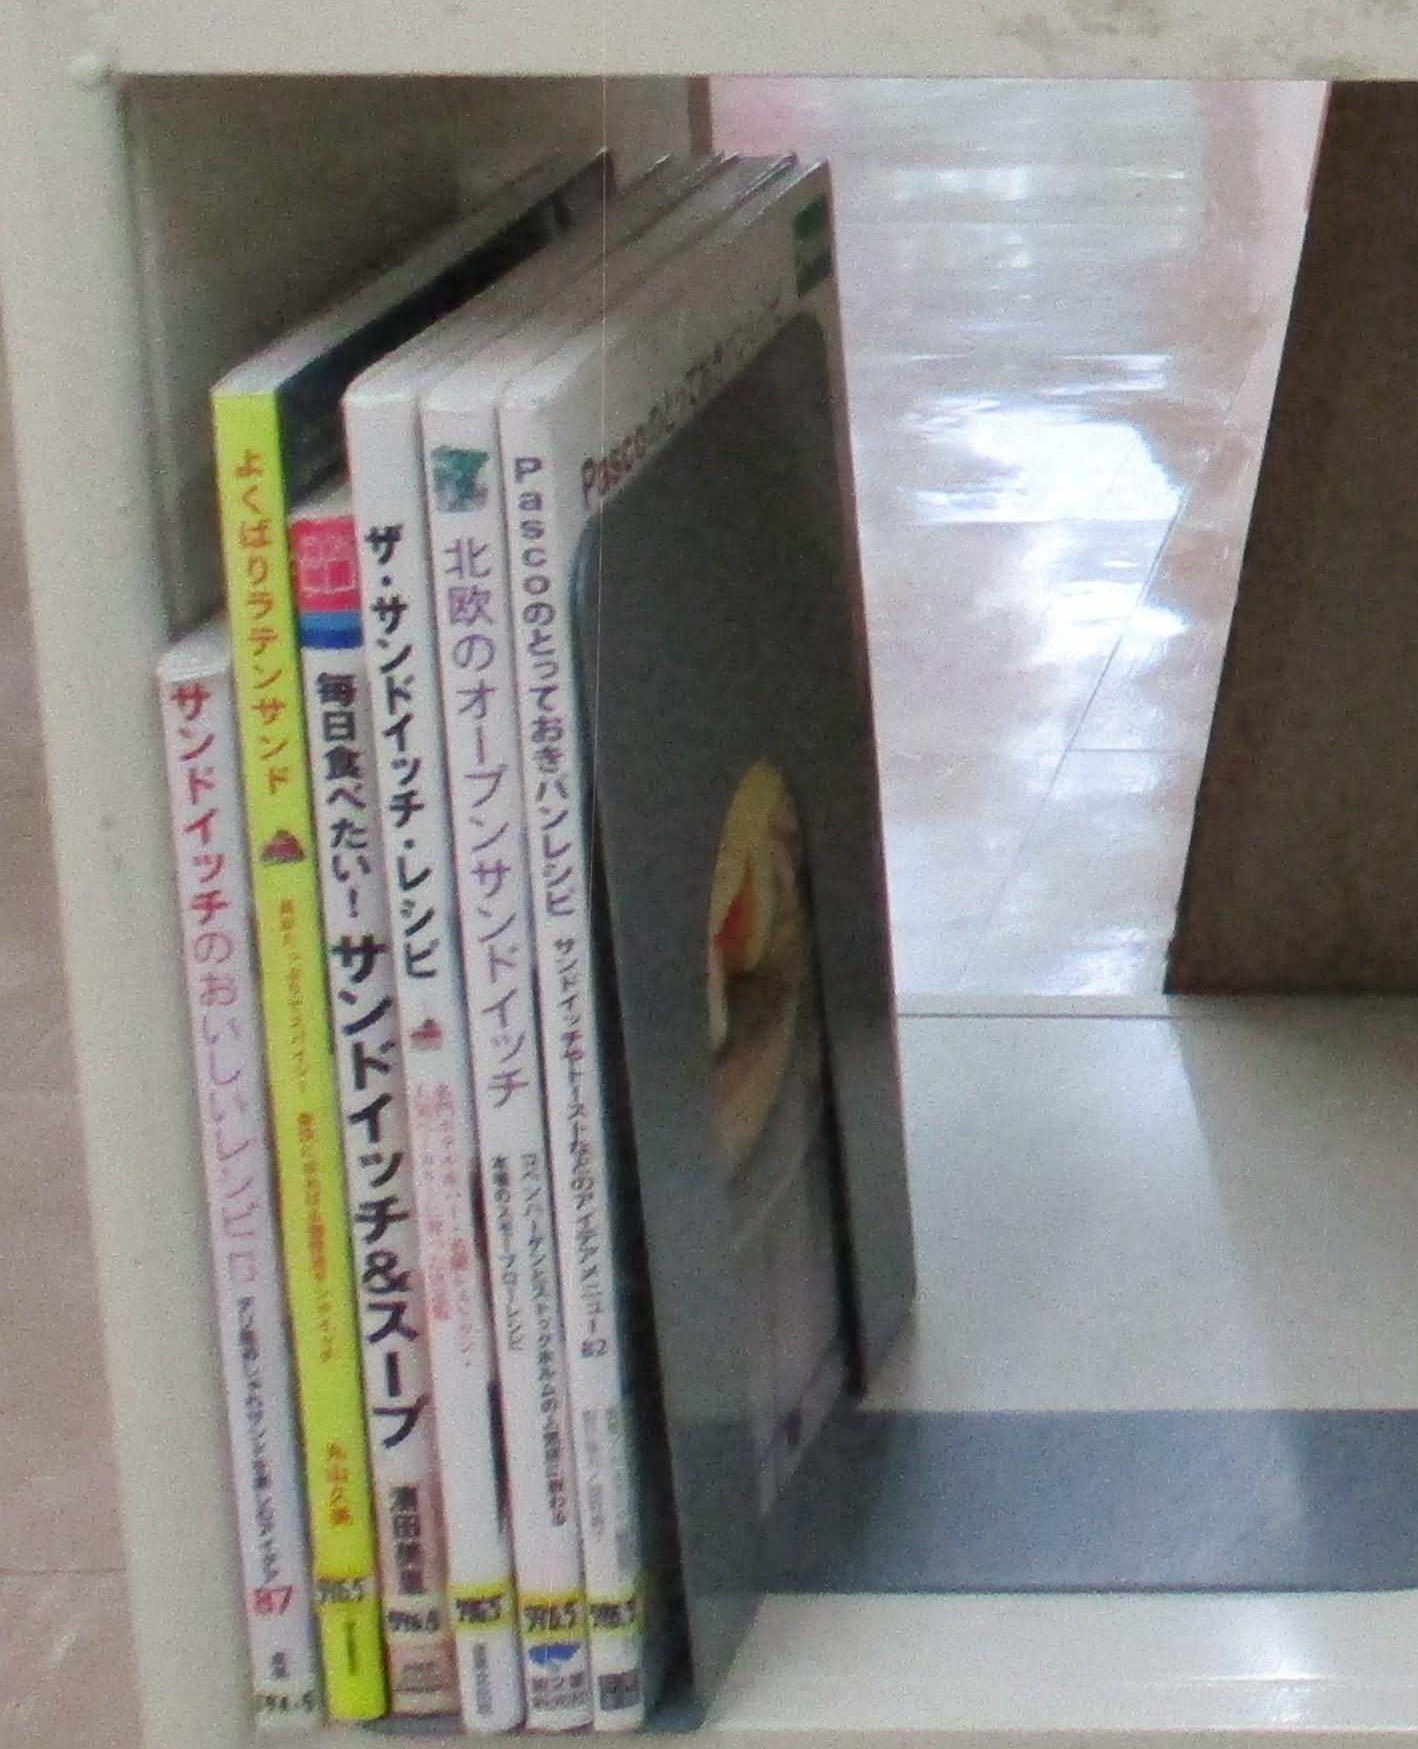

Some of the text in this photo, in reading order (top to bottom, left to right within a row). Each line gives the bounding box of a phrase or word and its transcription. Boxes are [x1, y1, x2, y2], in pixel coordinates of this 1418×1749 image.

[231, 447, 293, 795] よくばりラテンサンド
[364, 524, 438, 980] ザ・サンドイッチ・レシピ
[444, 536, 530, 1110] 北欧のオープンサンドイッチ
[514, 456, 576, 919] Pascoのとっておきパンレシピ
